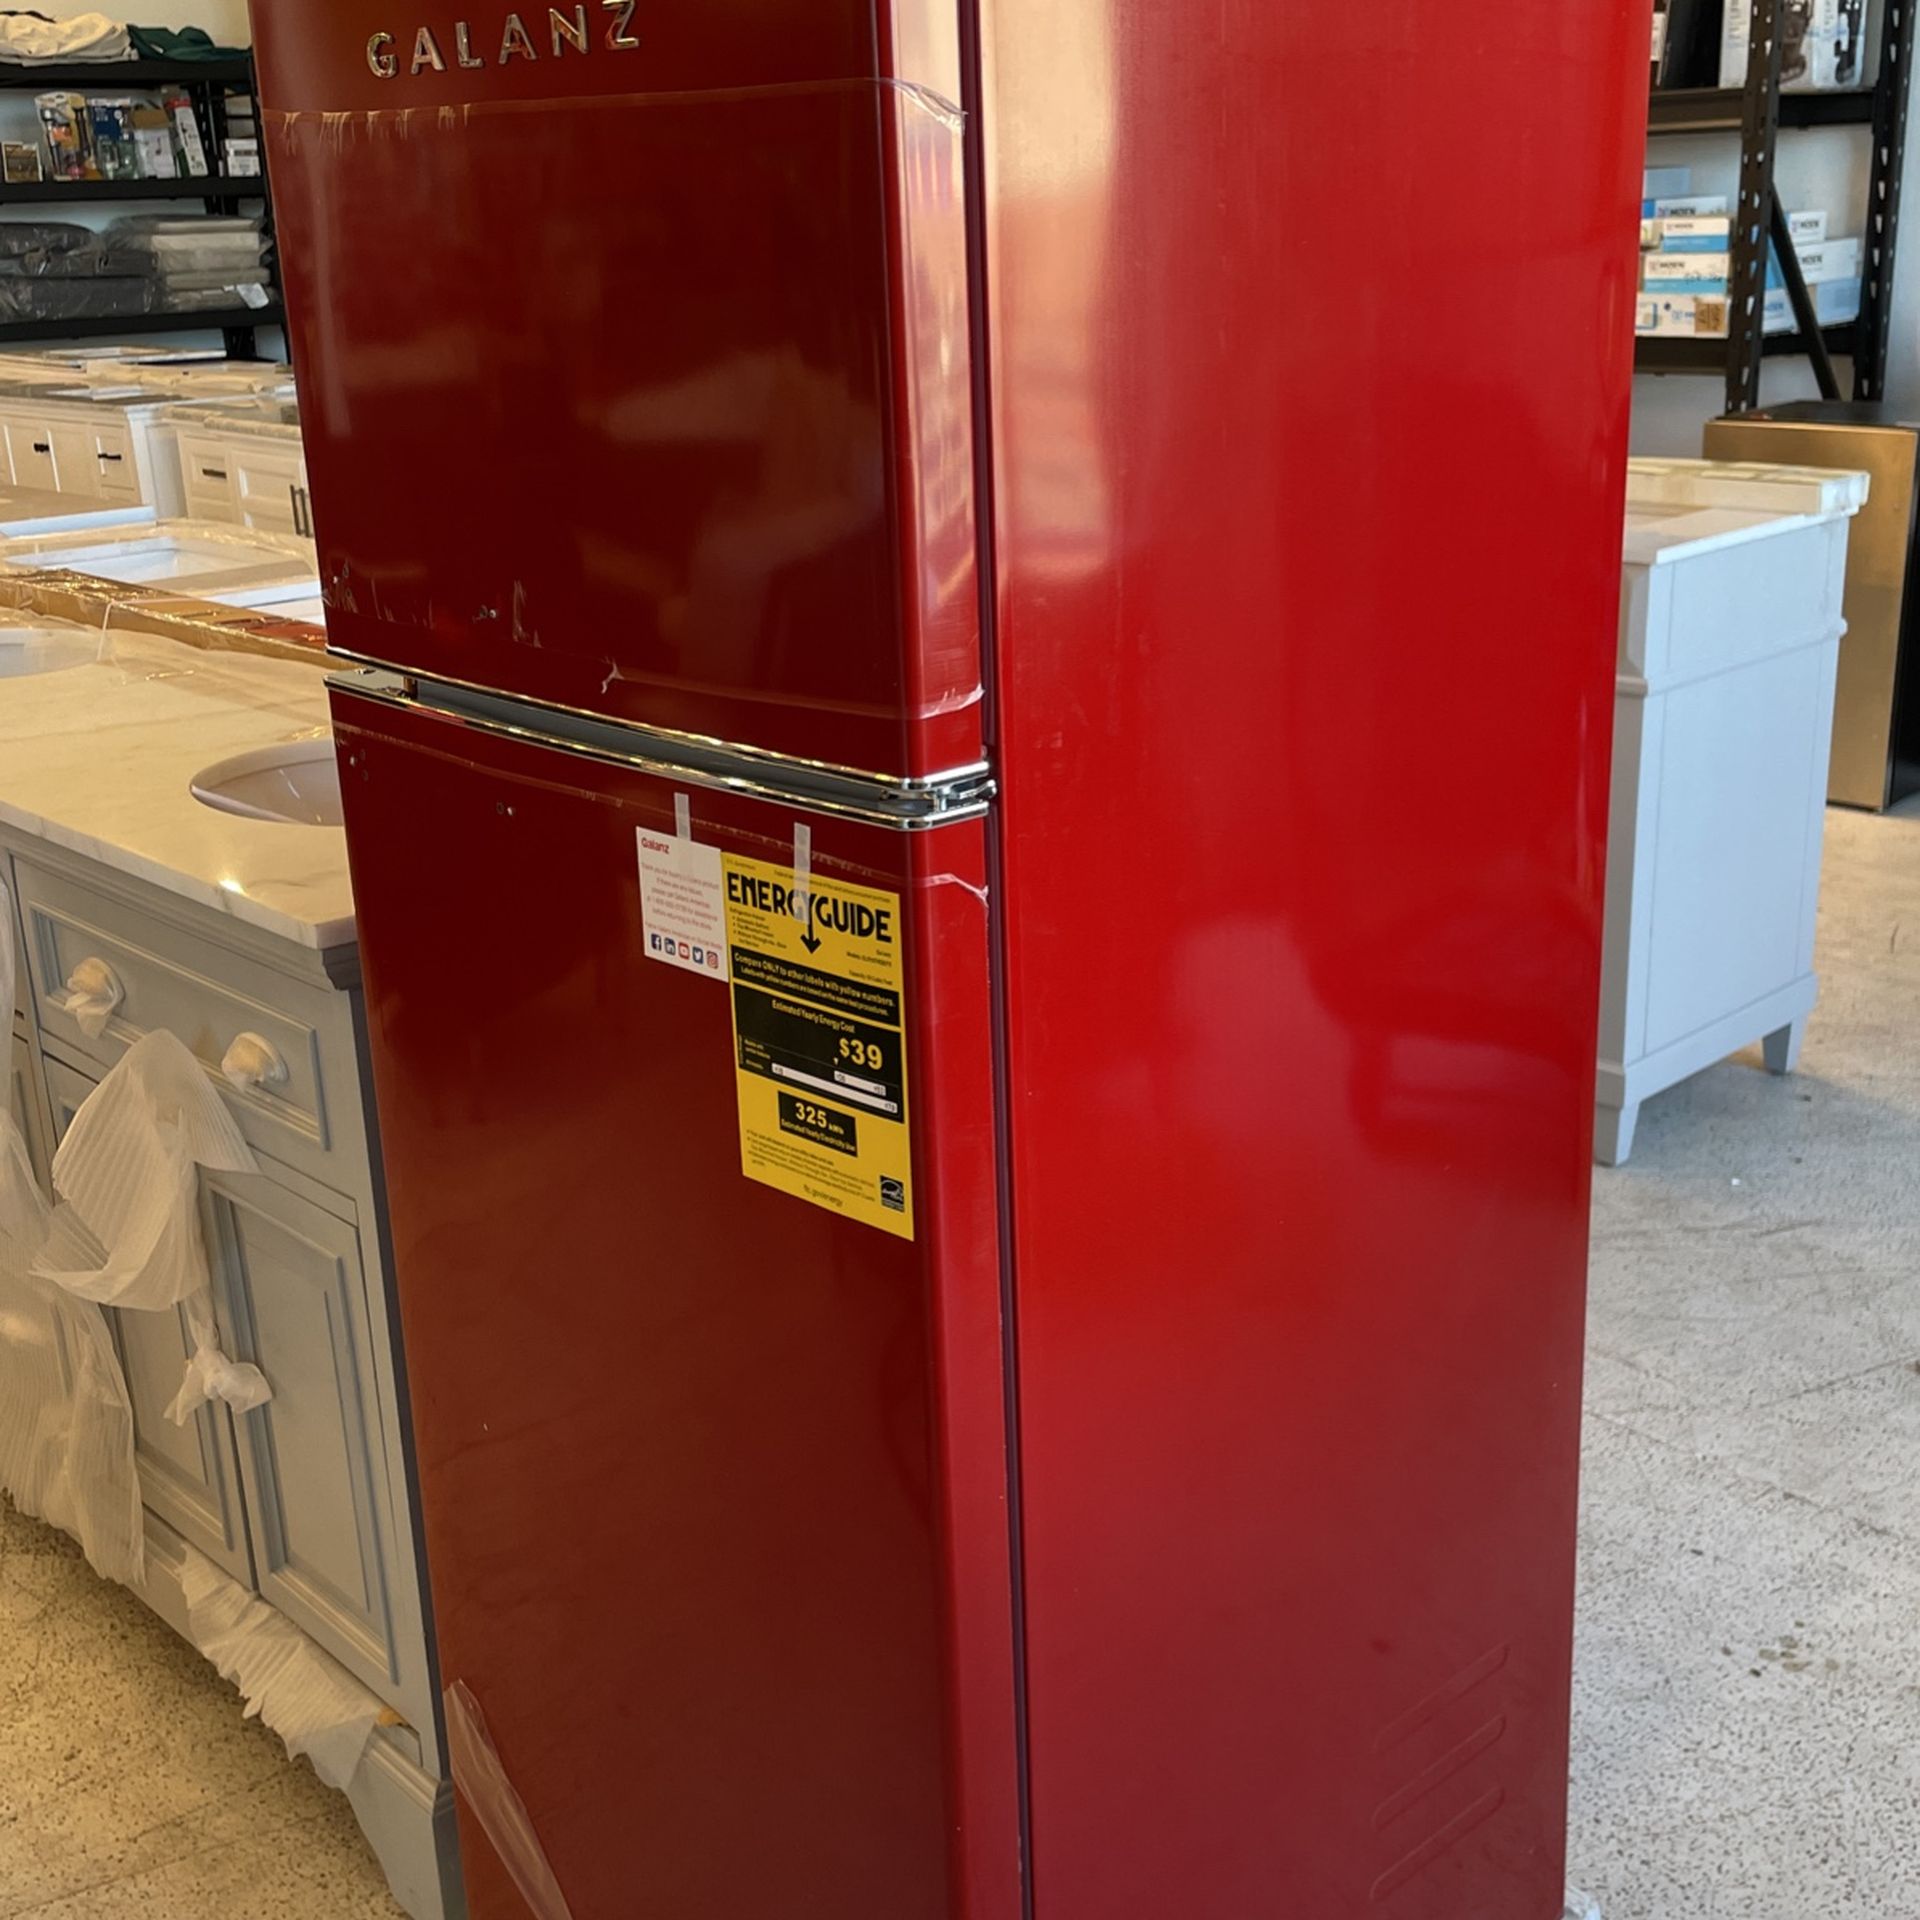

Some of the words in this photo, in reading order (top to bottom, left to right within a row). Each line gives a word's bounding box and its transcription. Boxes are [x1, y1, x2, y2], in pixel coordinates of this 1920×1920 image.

[366, 0, 639, 78] GALANZ
[641, 836, 669, 854] Galanz
[733, 952, 761, 969] Compare
[761, 960, 780, 973] ONLY
[786, 968, 804, 980] other
[804, 973, 824, 986] labels
[838, 984, 861, 1000] yellow
[771, 999, 800, 1015] Estimated
[800, 1008, 818, 1023] Yearly
[818, 1013, 840, 1030] Energy
[838, 1036, 883, 1071] $39
[795, 1102, 827, 1129] 325
